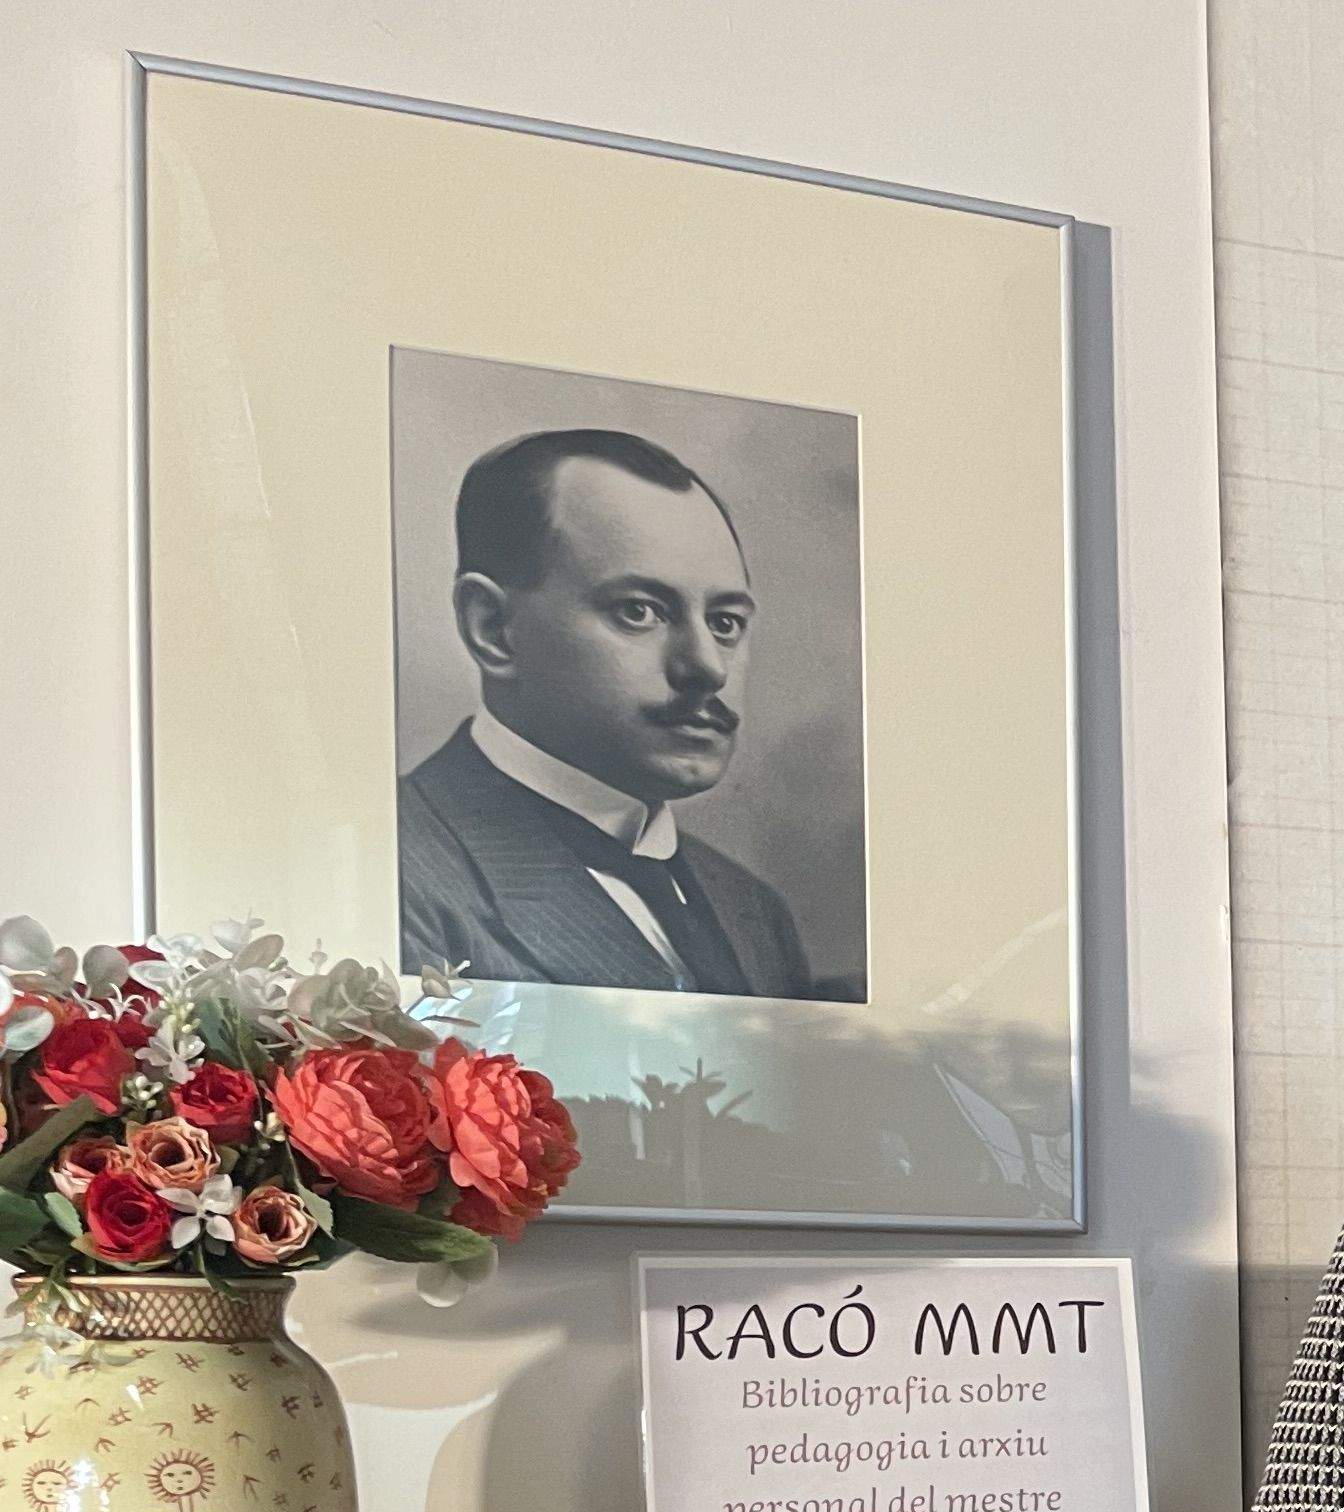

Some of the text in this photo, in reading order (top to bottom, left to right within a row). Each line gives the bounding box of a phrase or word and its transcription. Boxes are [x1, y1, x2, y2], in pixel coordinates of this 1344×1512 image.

[676, 1284, 1104, 1361] RACÓ MMT
[741, 1374, 1048, 1416] Bibliografia sobre
[746, 1430, 1049, 1475] pedagogia i arxiu
